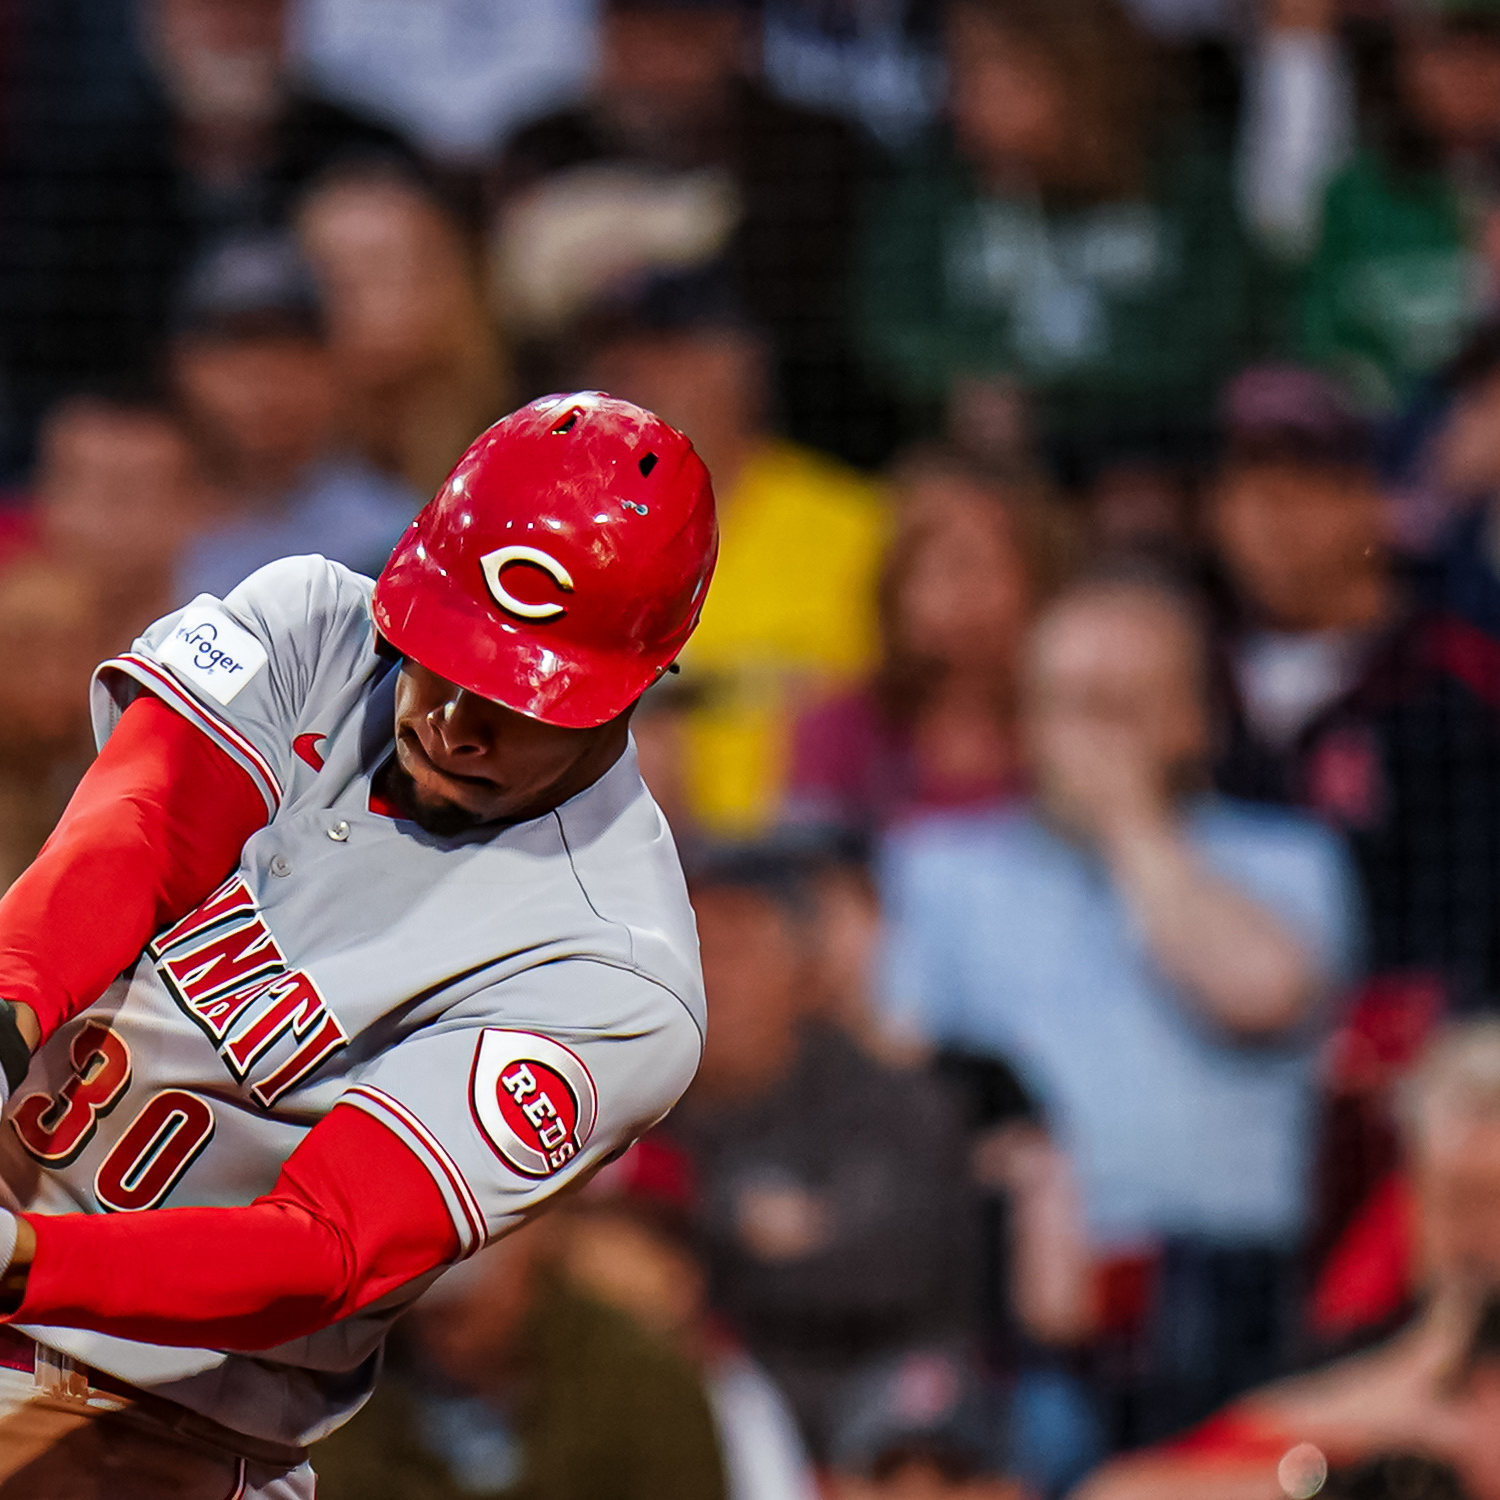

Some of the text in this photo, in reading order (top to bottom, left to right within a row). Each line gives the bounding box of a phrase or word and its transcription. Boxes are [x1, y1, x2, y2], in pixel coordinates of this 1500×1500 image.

[480, 545, 574, 619] C
[175, 622, 244, 674] Kroger
[9, 1019, 216, 1213] 30
[502, 1063, 575, 1169] REDS
